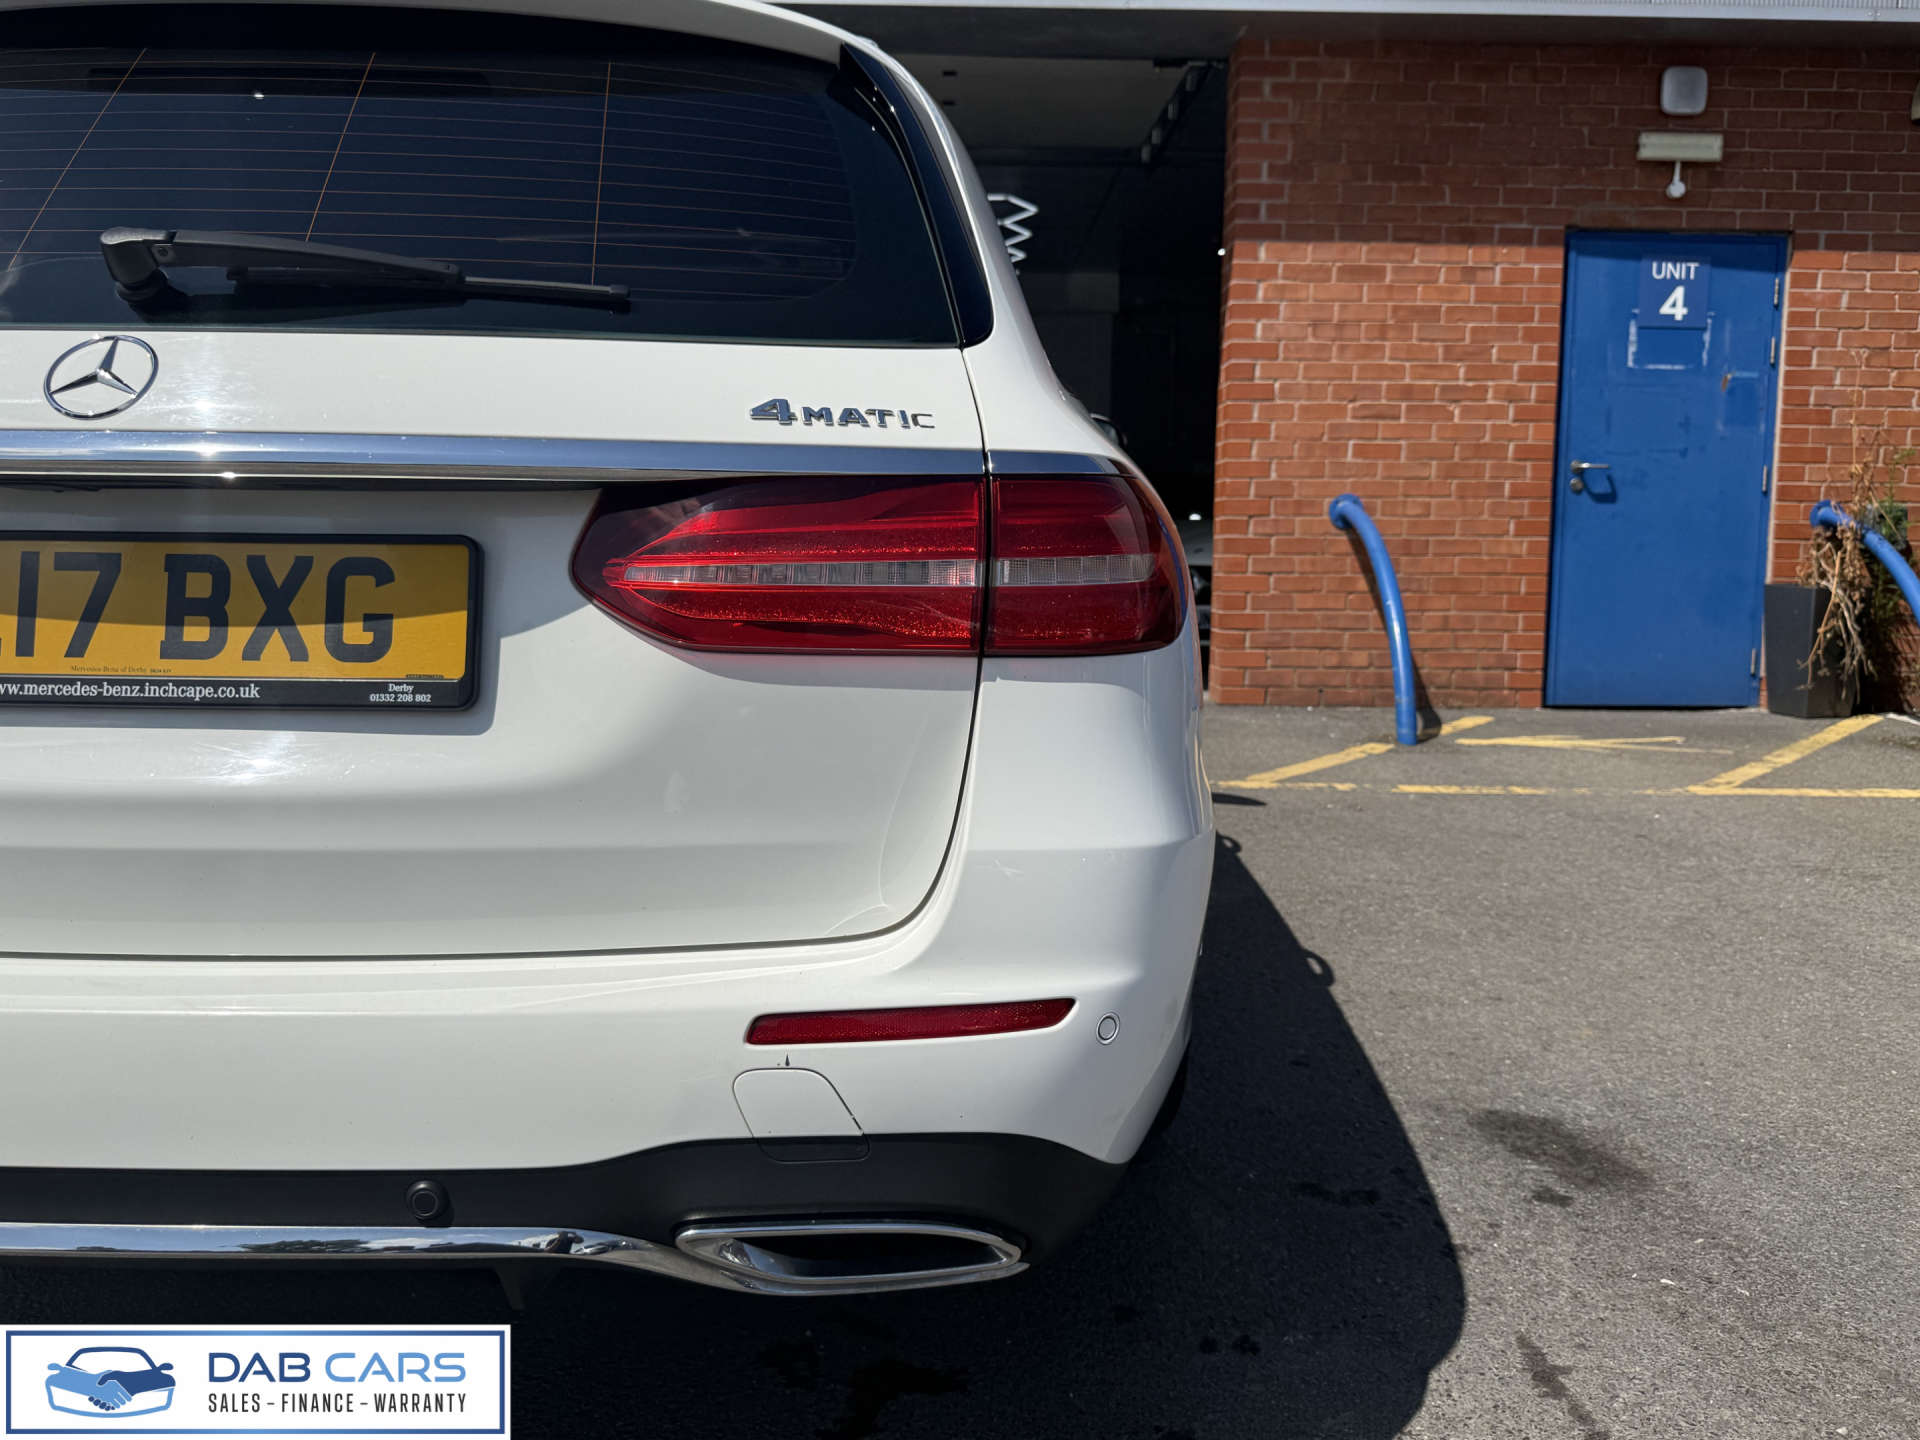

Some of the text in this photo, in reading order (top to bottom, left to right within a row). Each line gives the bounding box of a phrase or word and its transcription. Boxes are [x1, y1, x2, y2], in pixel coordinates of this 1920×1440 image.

[1652, 261, 1700, 280] UNIT
[1659, 285, 1689, 321] 4
[750, 398, 936, 429] 4MATIC
[0, 551, 396, 664] 17 BXG
[369, 693, 395, 702] 01332
[388, 683, 415, 693] Derby
